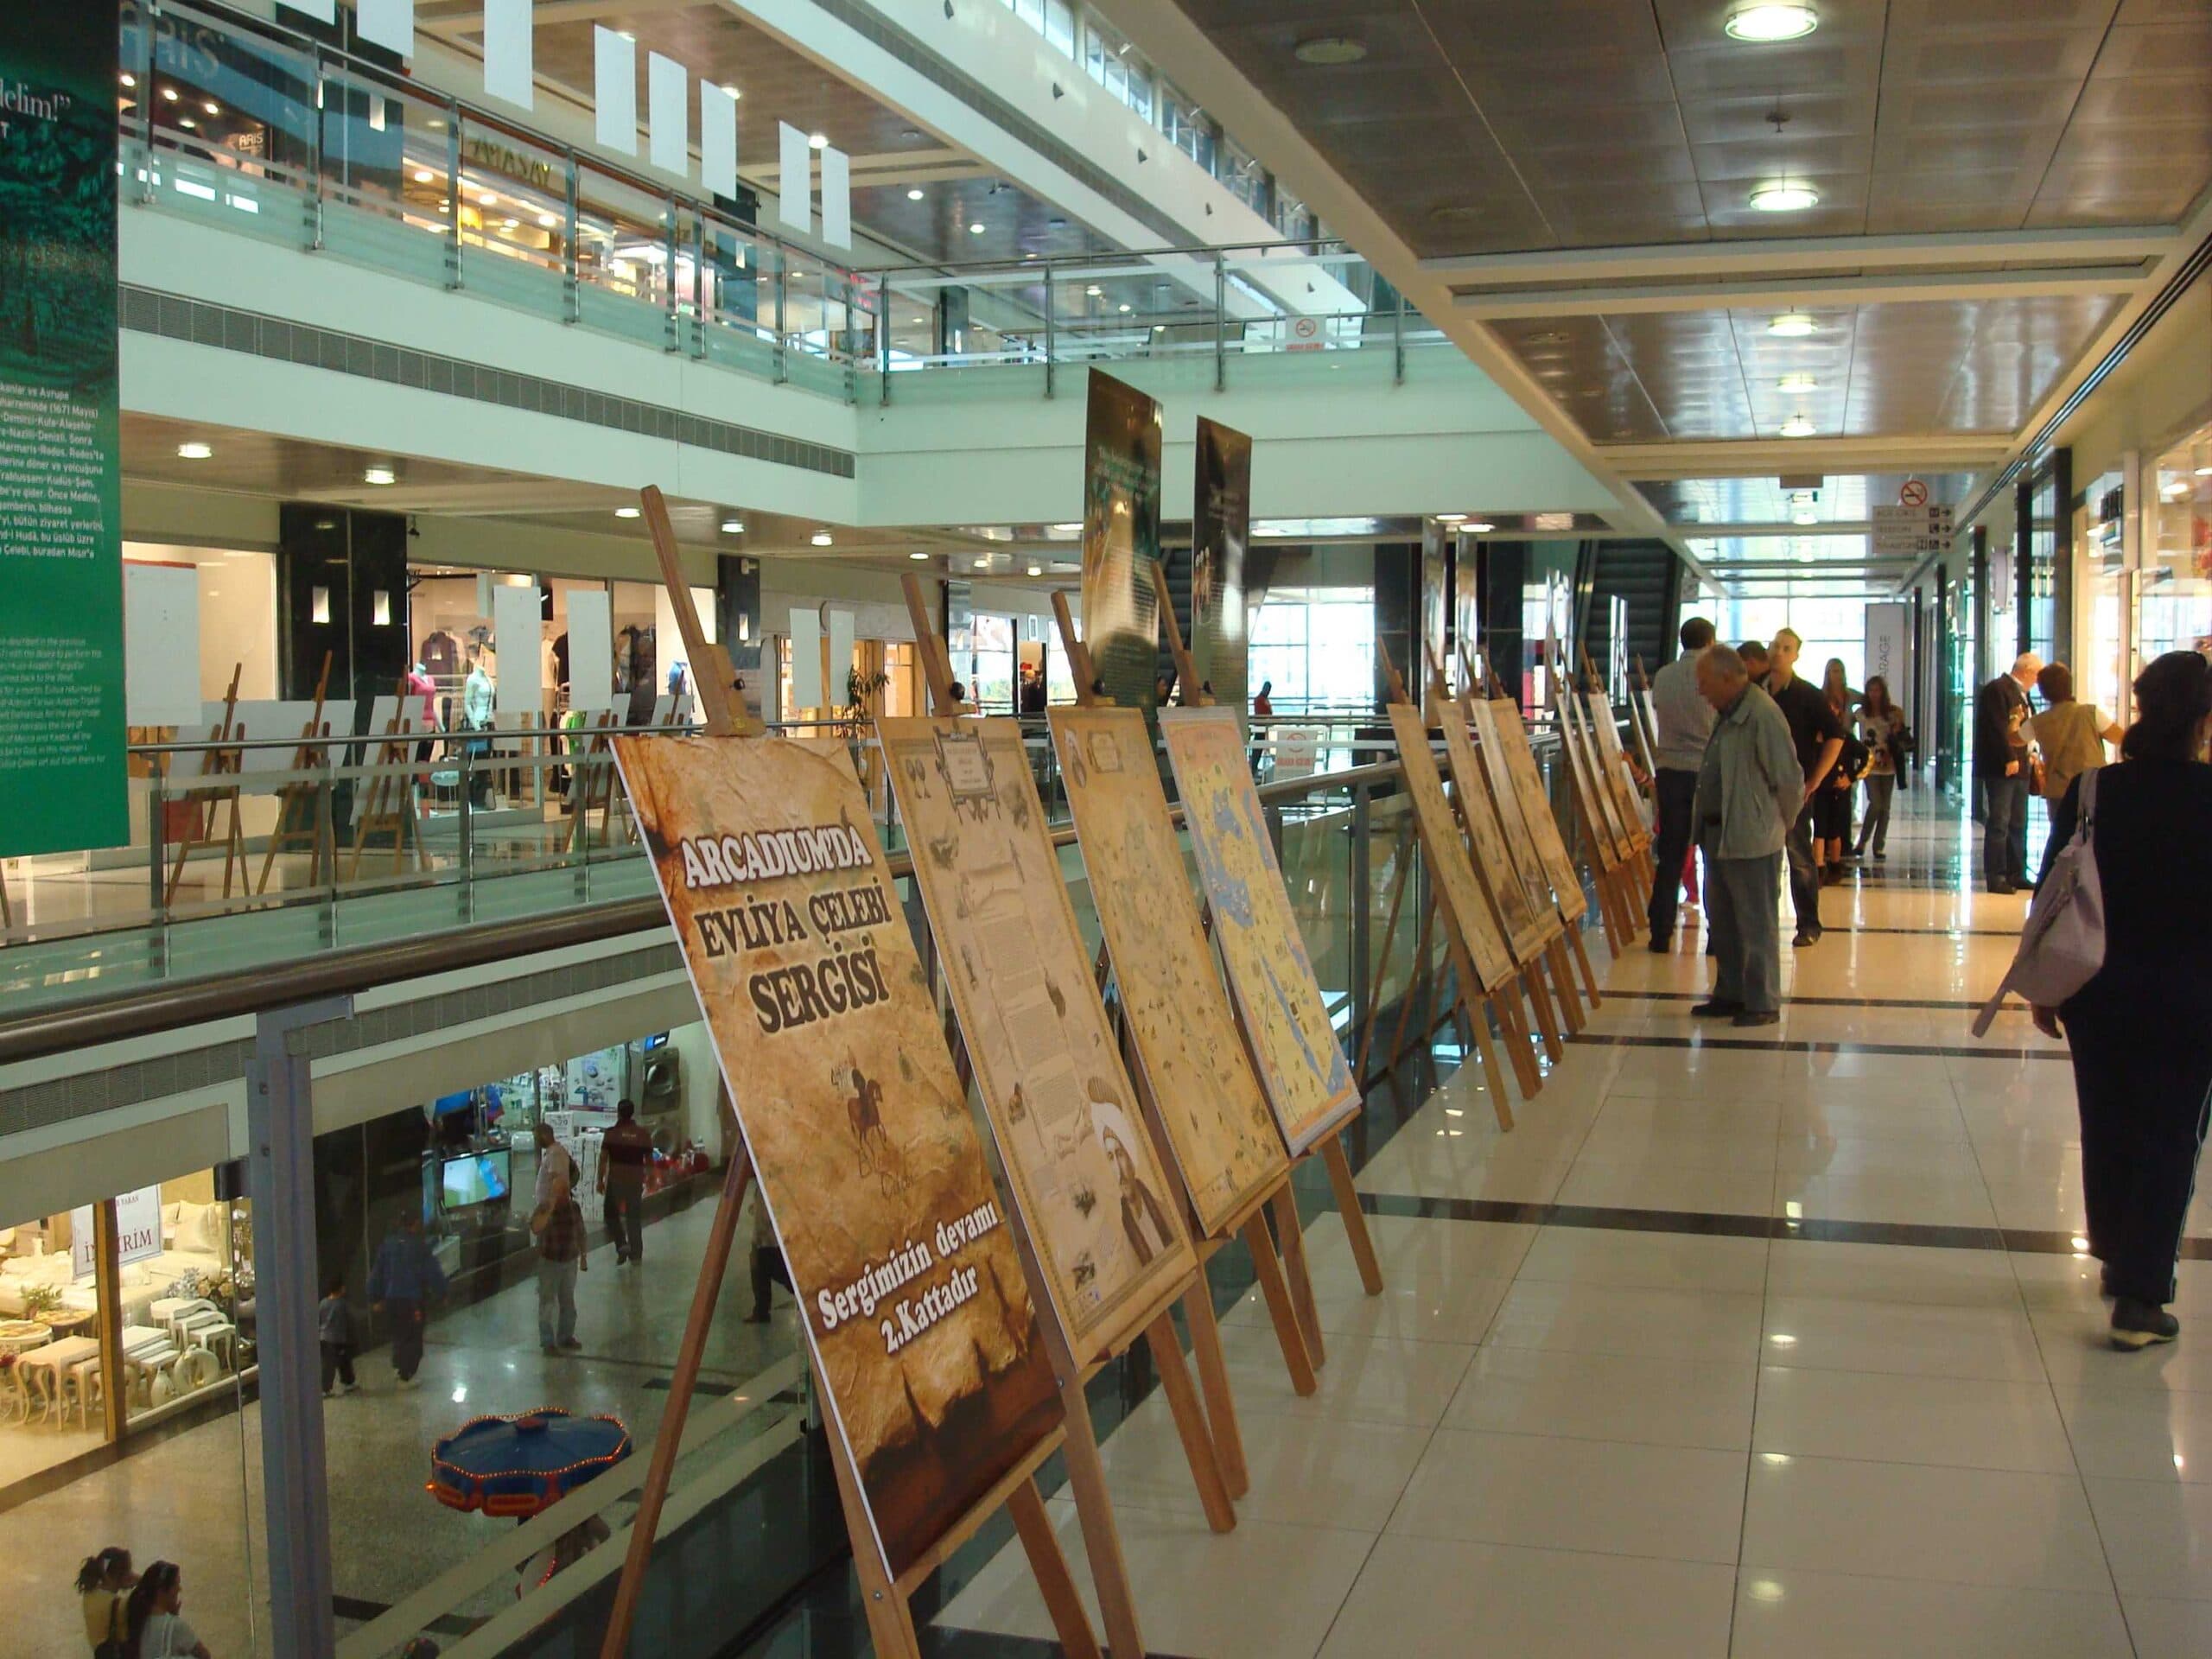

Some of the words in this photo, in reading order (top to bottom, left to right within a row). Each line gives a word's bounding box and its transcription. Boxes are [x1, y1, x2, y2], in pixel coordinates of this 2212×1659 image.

[28, 388, 37, 397] ve
[40, 387, 69, 401] Avrupa
[52, 463, 61, 472] ve
[681, 824, 874, 889] ARCADIUM'DA
[694, 894, 808, 957] EVLİYA
[808, 875, 892, 944] ÇELEBİ
[748, 935, 890, 1033] SERGİSİ
[84, 1227, 153, 1263] İRİM
[817, 1239, 934, 1330] Sergimizin
[936, 1201, 999, 1257] devamı
[881, 1266, 978, 1354] 2.Kattadır
